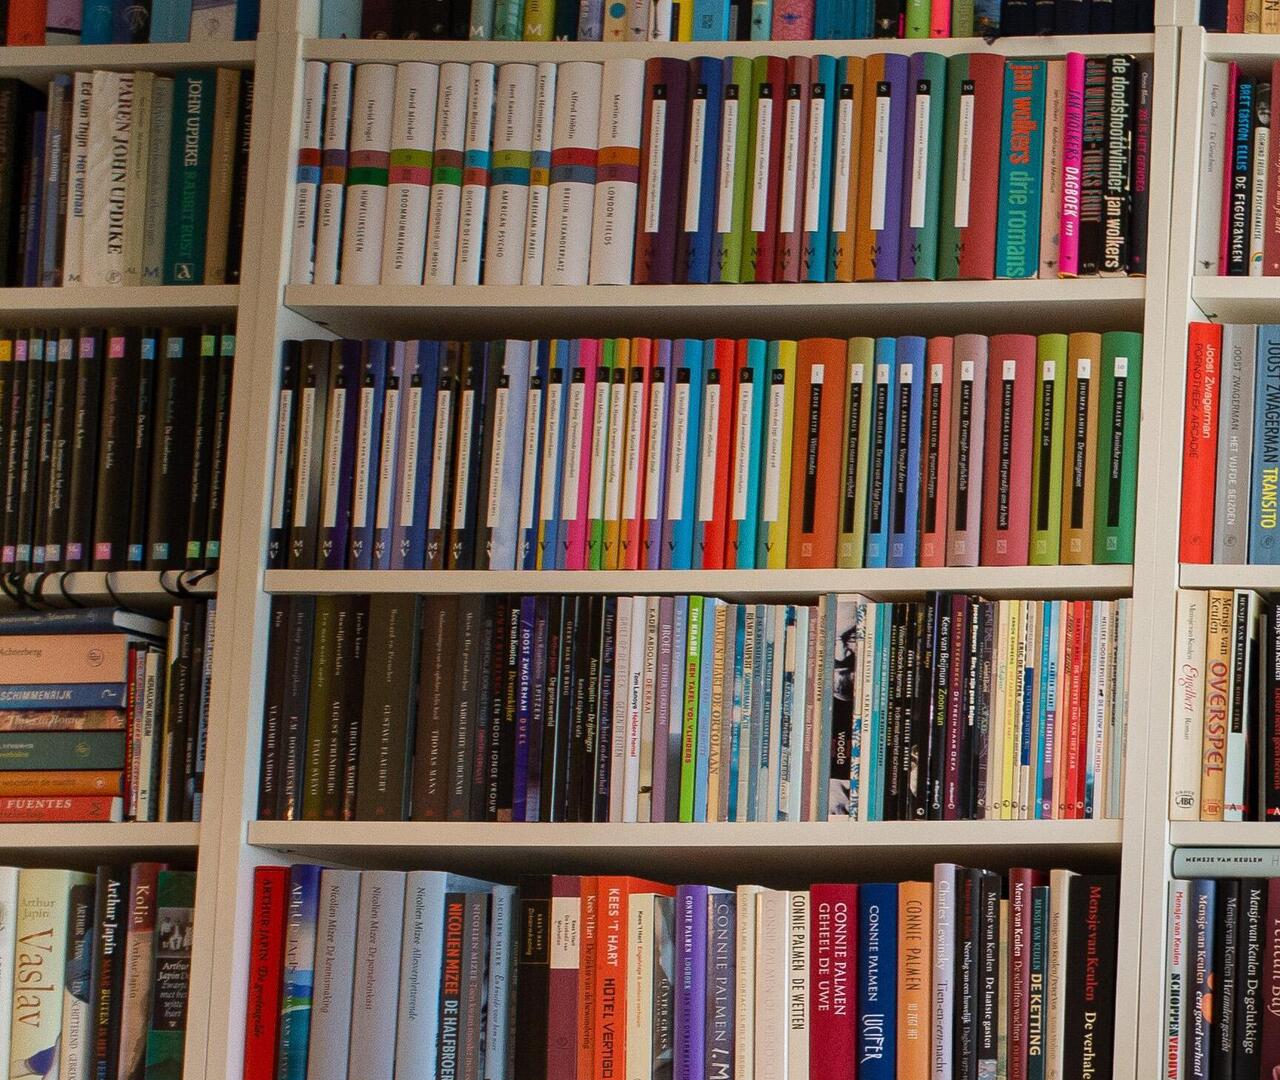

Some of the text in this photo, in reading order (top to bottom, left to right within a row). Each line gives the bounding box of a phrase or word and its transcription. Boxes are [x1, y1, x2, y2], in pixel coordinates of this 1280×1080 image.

[185, 79, 202, 166] JOHN UPDIKE
[107, 79, 132, 255] PAREN JOHN UPDIKE
[1005, 64, 1034, 277] jan wolkers drie romans
[1064, 167, 1079, 217] DAGBOEK
[1105, 58, 1129, 268] de doodshoofdvlinder jan wolkers
[1259, 468, 1278, 528] TRANSITO
[1206, 662, 1228, 777] OVERSPEL
[103, 880, 120, 954] Arthur Japin
[134, 885, 149, 924] Kolja
[446, 903, 463, 956] NICOLIEN
[16, 928, 54, 1028] Vaslav
[444, 959, 459, 994] MIZEE
[817, 903, 831, 1011] GEHEEL DE UWE
[832, 903, 847, 1015] CONNIE PALMEN
[443, 1000, 458, 1012] DE
[861, 1013, 884, 1064] LUCIFER
